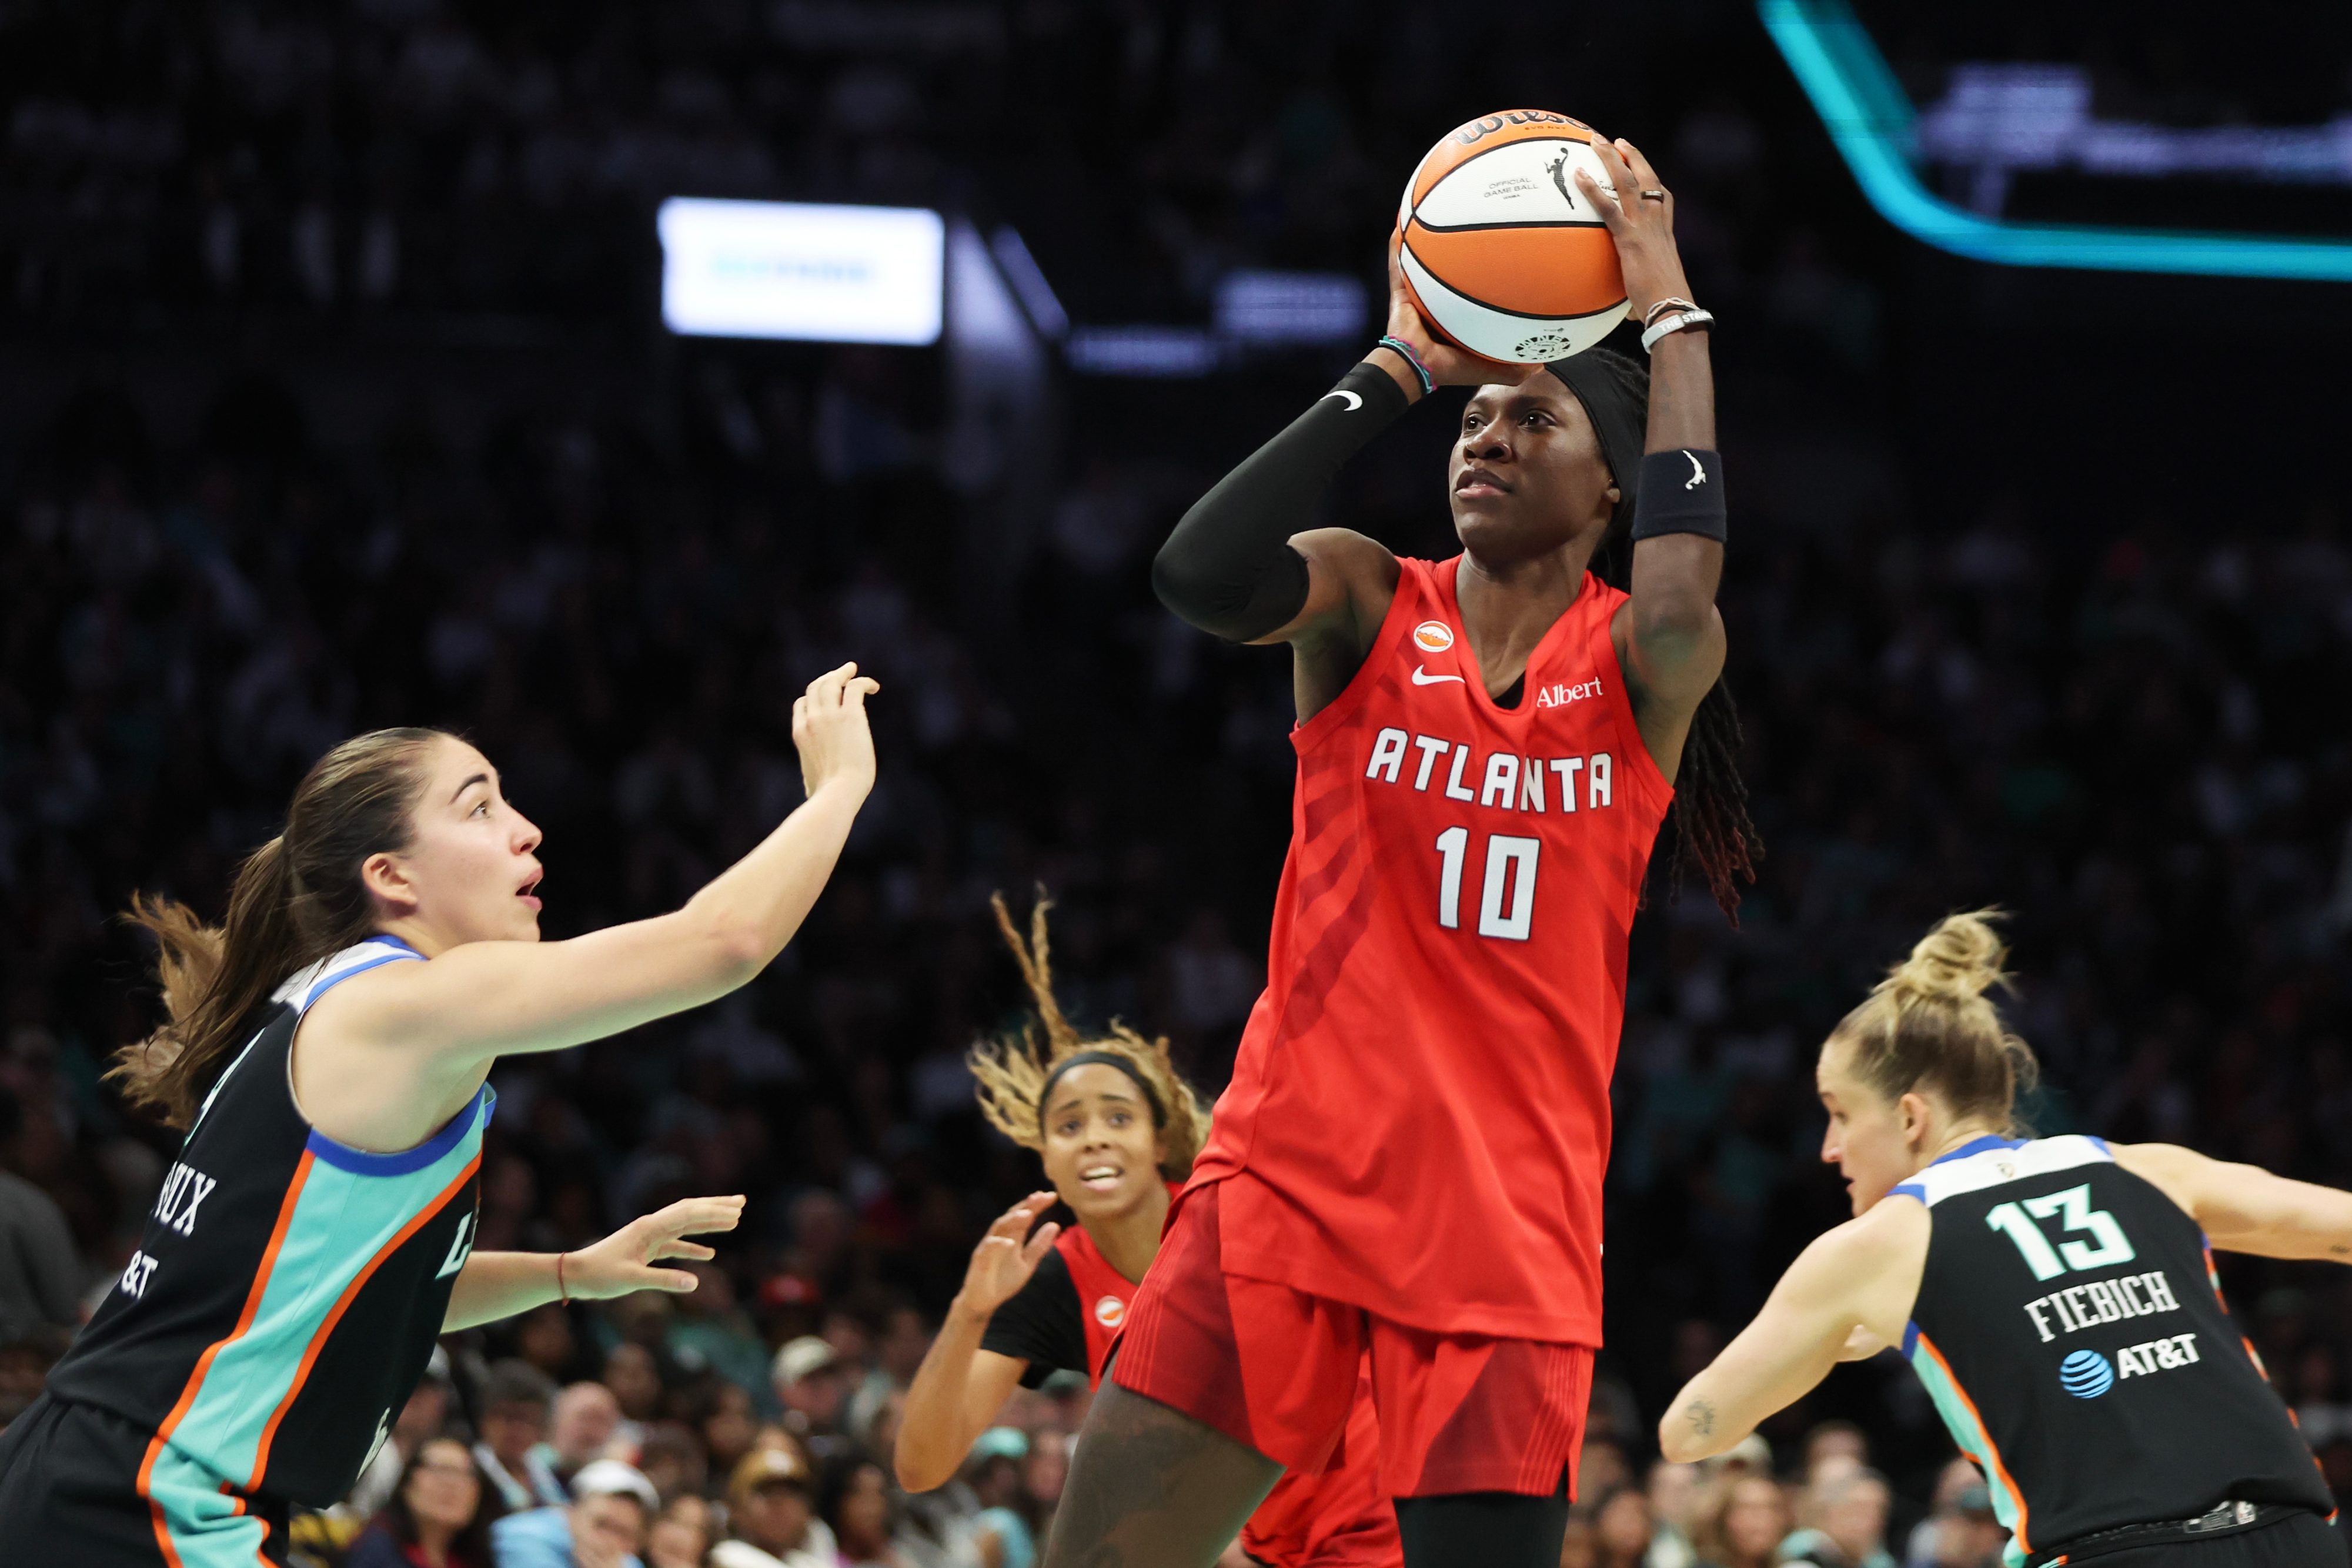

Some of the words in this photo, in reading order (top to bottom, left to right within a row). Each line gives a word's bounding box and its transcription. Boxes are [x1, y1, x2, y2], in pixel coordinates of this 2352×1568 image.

[1456, 111, 1598, 145] Wilso
[1484, 188, 1512, 198] GAME
[1489, 178, 1532, 189] OFFICIAL
[1659, 317, 1682, 332] THE
[1536, 676, 1603, 708] Albert
[1365, 726, 1612, 813] ATLANTA
[1435, 825, 1541, 941] 10
[1984, 1182, 2136, 1282] 13
[2023, 1271, 2180, 1343] FIEBICH
[2117, 1333, 2200, 1379] AT&T
